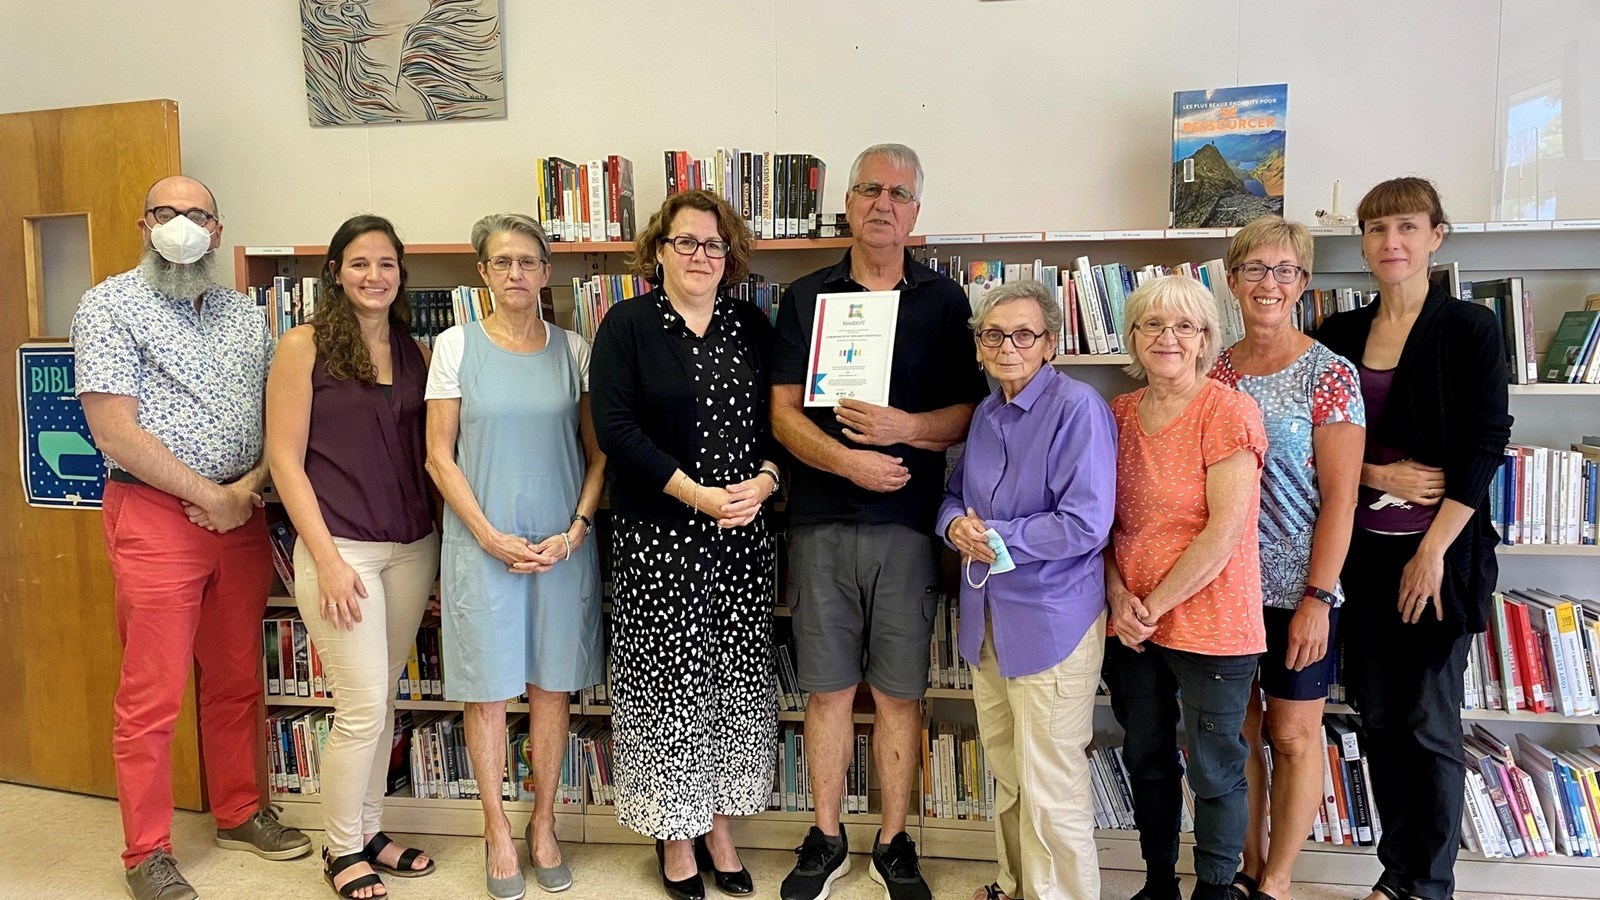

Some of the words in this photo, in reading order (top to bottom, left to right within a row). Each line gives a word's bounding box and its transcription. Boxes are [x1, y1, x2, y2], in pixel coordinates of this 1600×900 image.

[1183, 116, 1275, 132] RESSOURCER
[763, 200, 769, 208] EN
[1552, 635, 1562, 657] SIMPLE
[1559, 672, 1567, 689] TOUT
